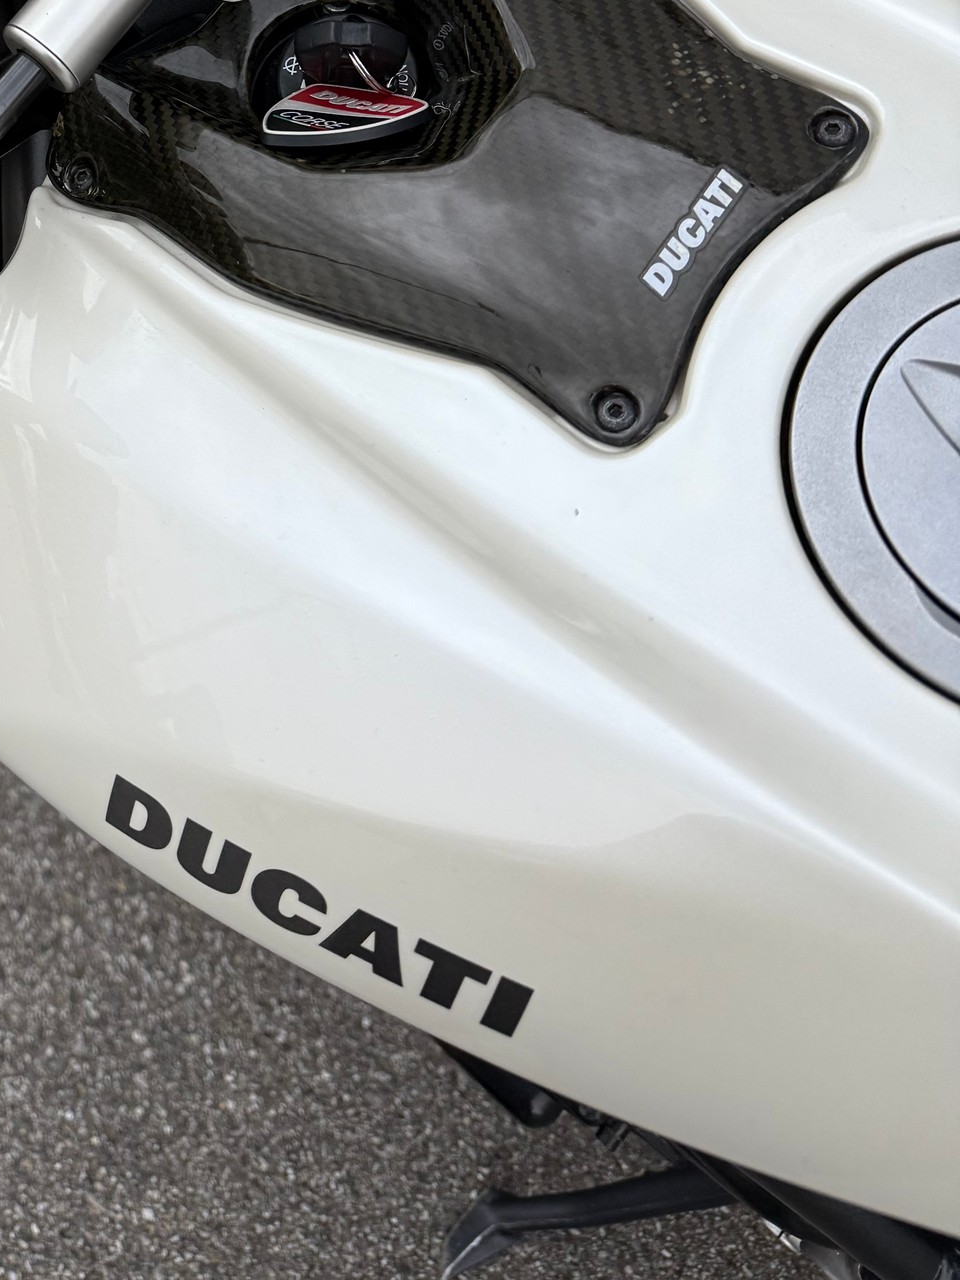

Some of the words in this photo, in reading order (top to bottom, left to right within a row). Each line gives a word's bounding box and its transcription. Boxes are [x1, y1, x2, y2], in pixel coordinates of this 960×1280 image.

[279, 111, 350, 130] CORSE
[310, 90, 413, 114] DUCATI
[642, 168, 743, 297] DUCATI
[105, 774, 535, 1038] DUCATI
